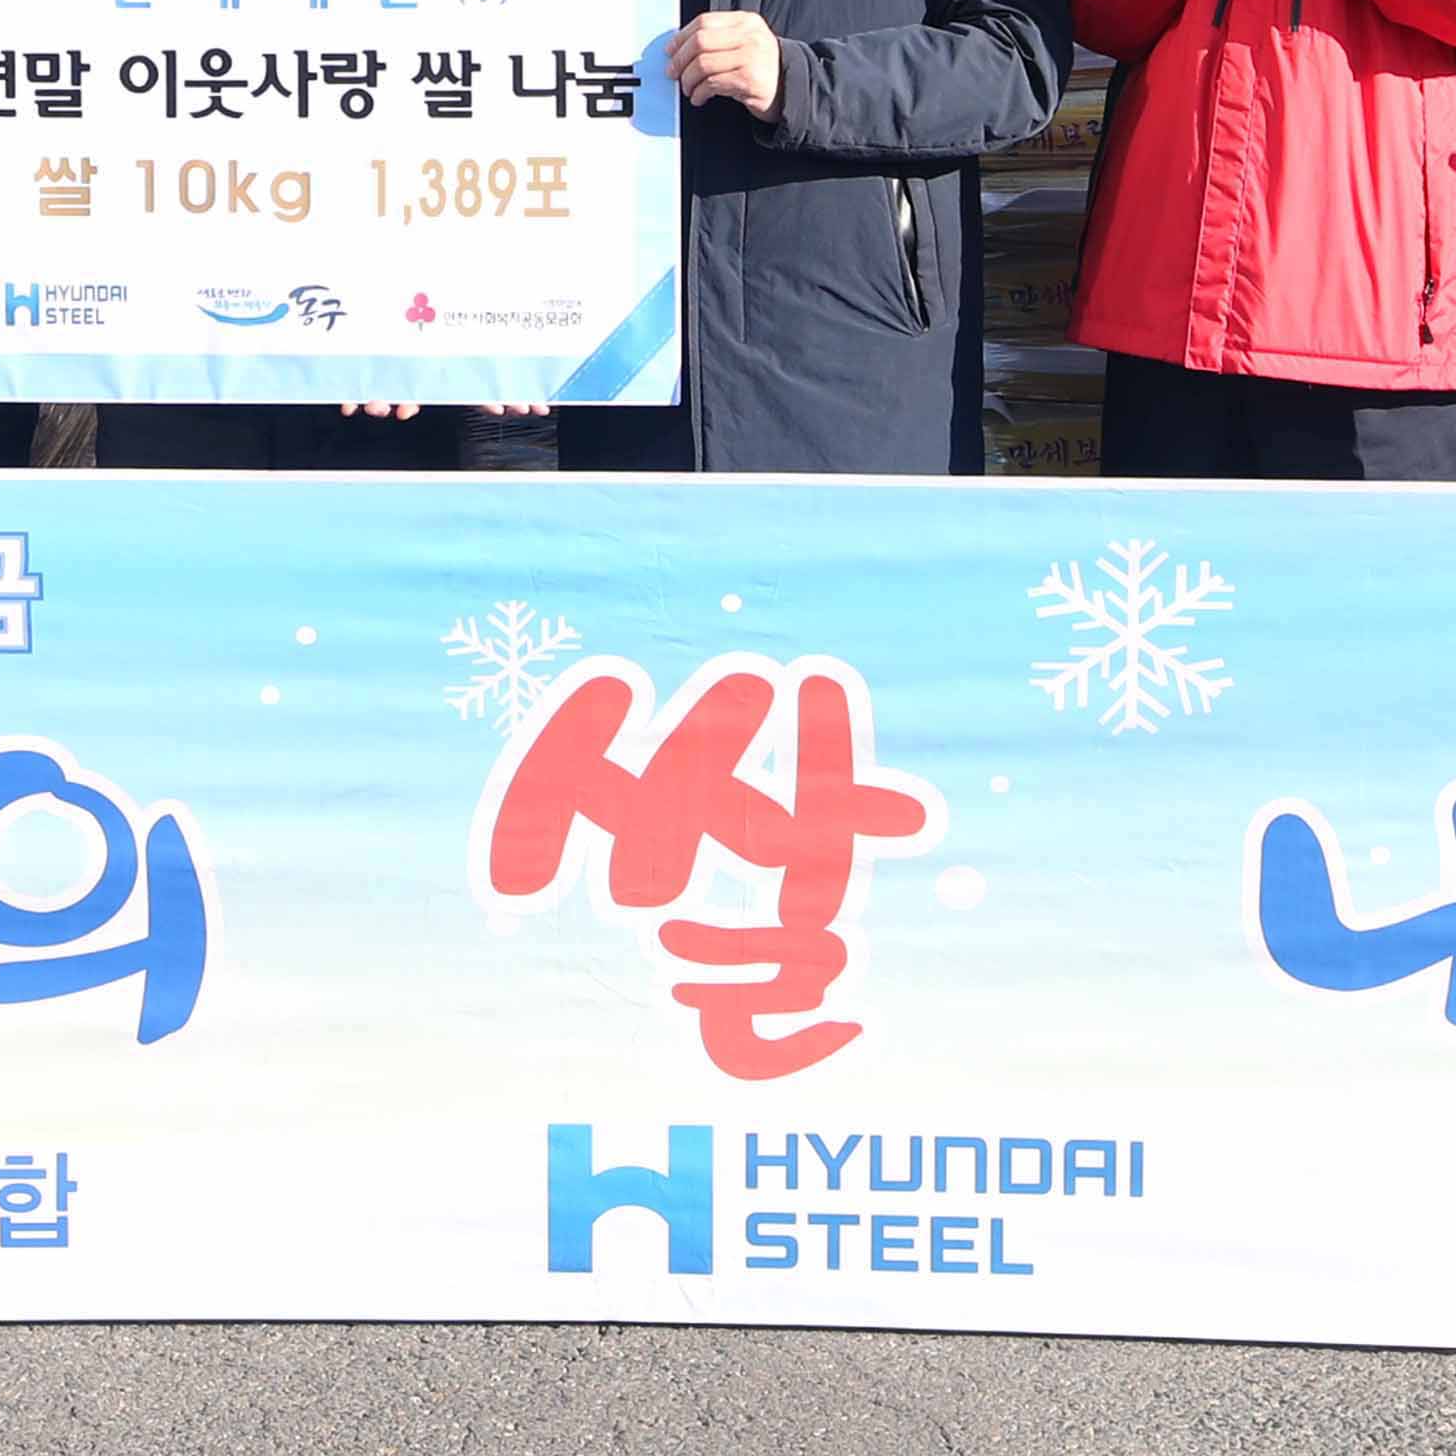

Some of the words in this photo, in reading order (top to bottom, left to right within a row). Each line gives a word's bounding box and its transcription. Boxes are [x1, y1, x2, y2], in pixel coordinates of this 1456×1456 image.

[118, 47, 388, 121] 이웃사랑
[411, 50, 482, 119] 쌀
[508, 50, 643, 120] 나눔
[33, 155, 99, 218] 쌀
[134, 157, 313, 223] 10kg
[371, 155, 572, 225] 1,389포
[45, 285, 128, 303] HYUNDAI
[45, 307, 106, 326] STEEL
[288, 284, 347, 332] 동구
[488, 671, 928, 1082] 쌀
[744, 1133, 1145, 1198] HYUNDAI
[744, 1212, 1034, 1276] STEEL
